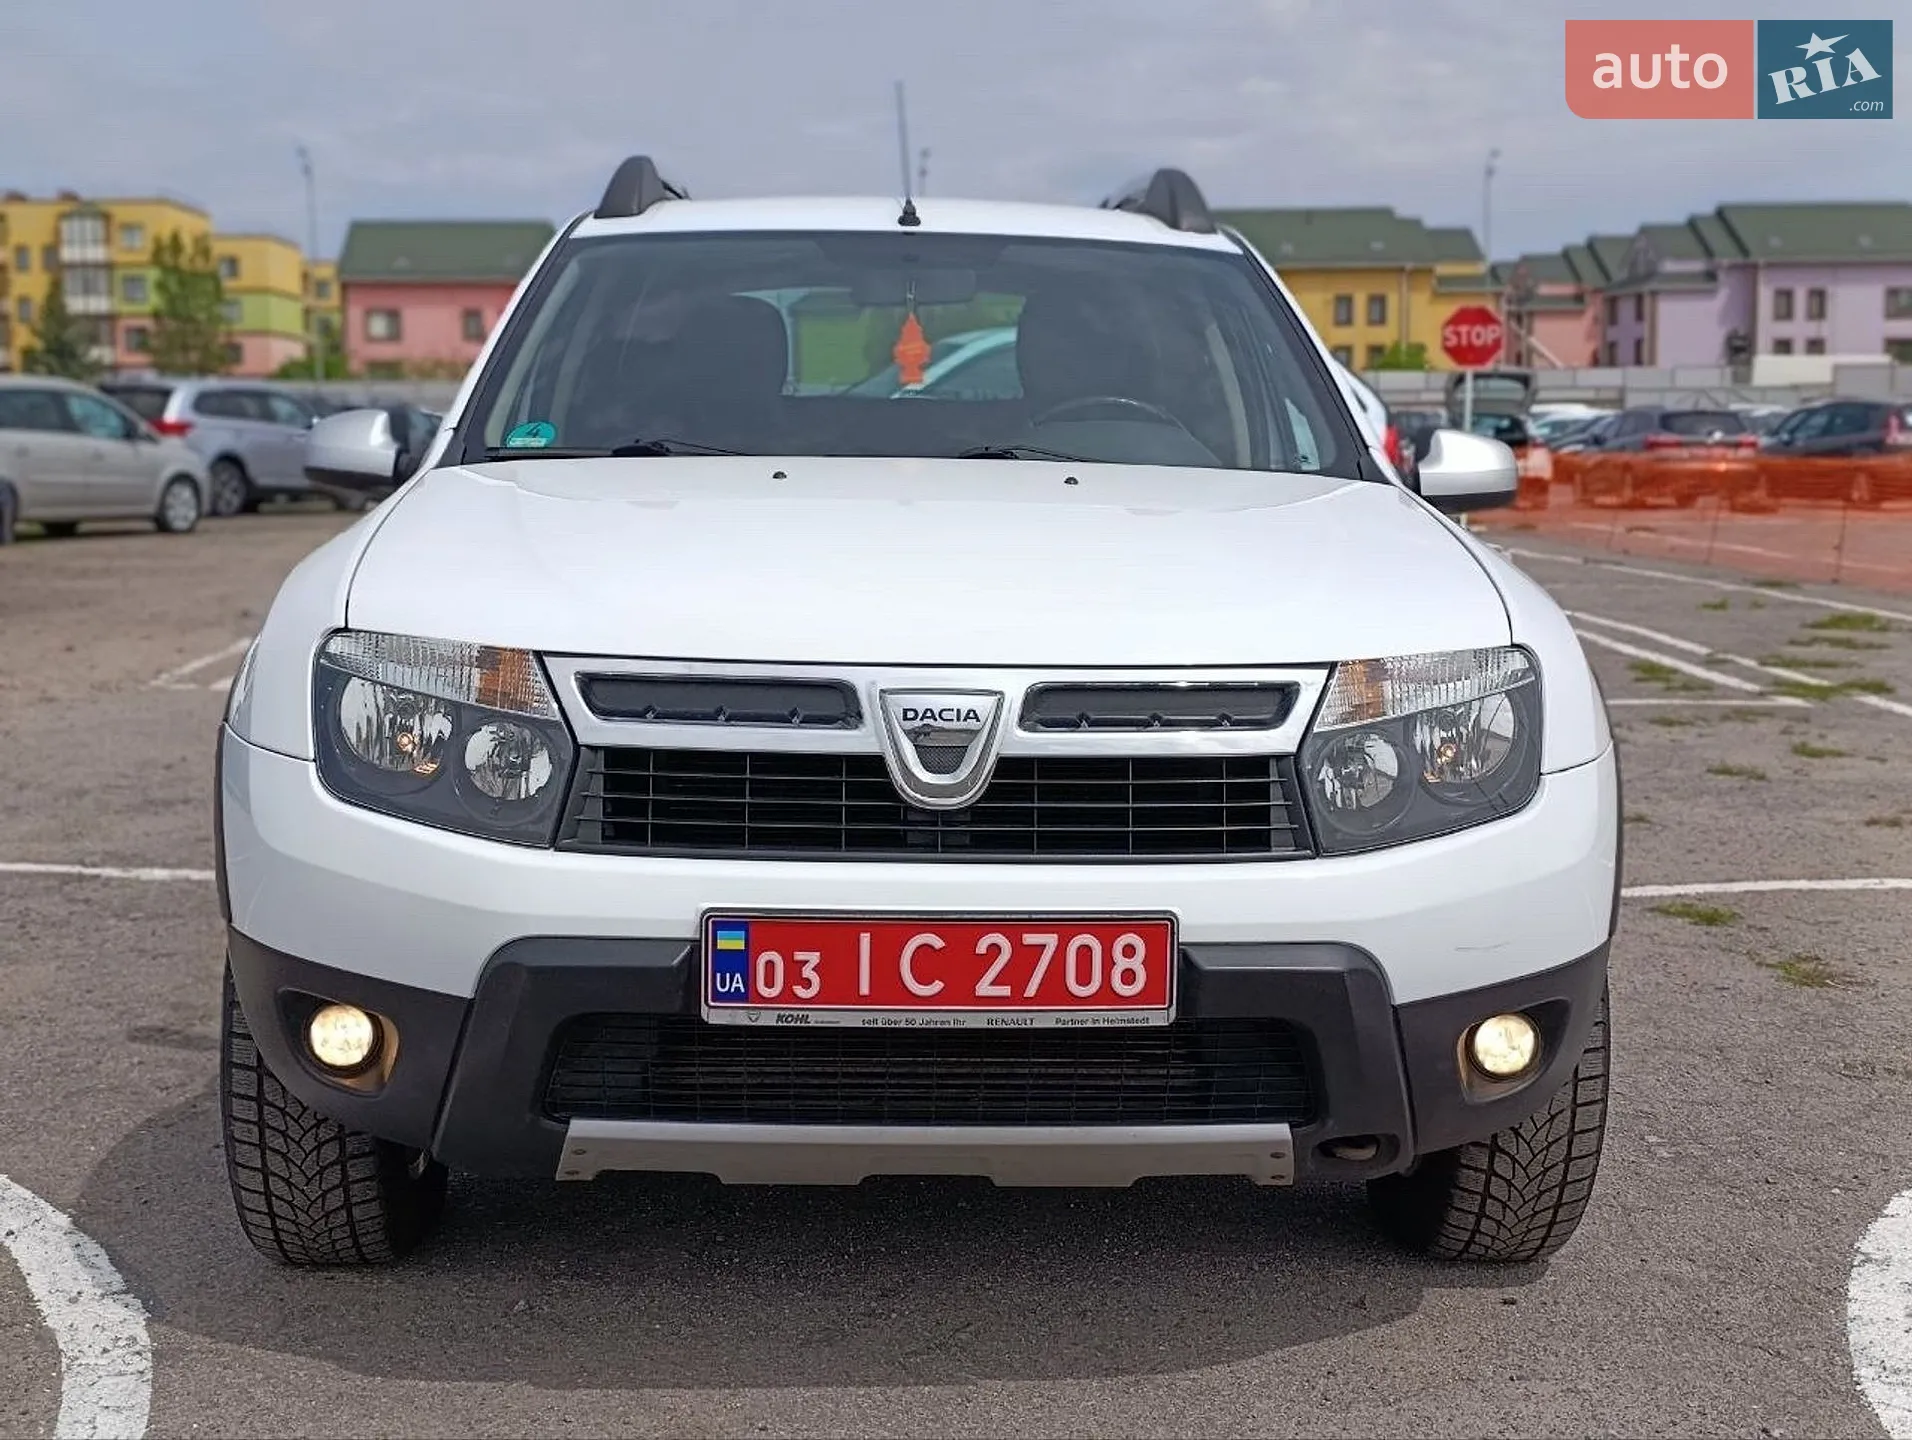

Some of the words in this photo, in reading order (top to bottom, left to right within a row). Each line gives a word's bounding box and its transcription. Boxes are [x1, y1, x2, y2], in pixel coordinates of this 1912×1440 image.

[1444, 324, 1501, 347] STOP
[526, 423, 543, 438] 4
[902, 708, 981, 722] DACIA
[755, 951, 822, 999] 03
[975, 932, 1148, 998] 2708
[716, 972, 745, 993] UA
[775, 1013, 812, 1025] KOHL
[905, 1018, 917, 1026] 50
[986, 1018, 1035, 1027] RENAULT
[1055, 1017, 1088, 1026] Partner
